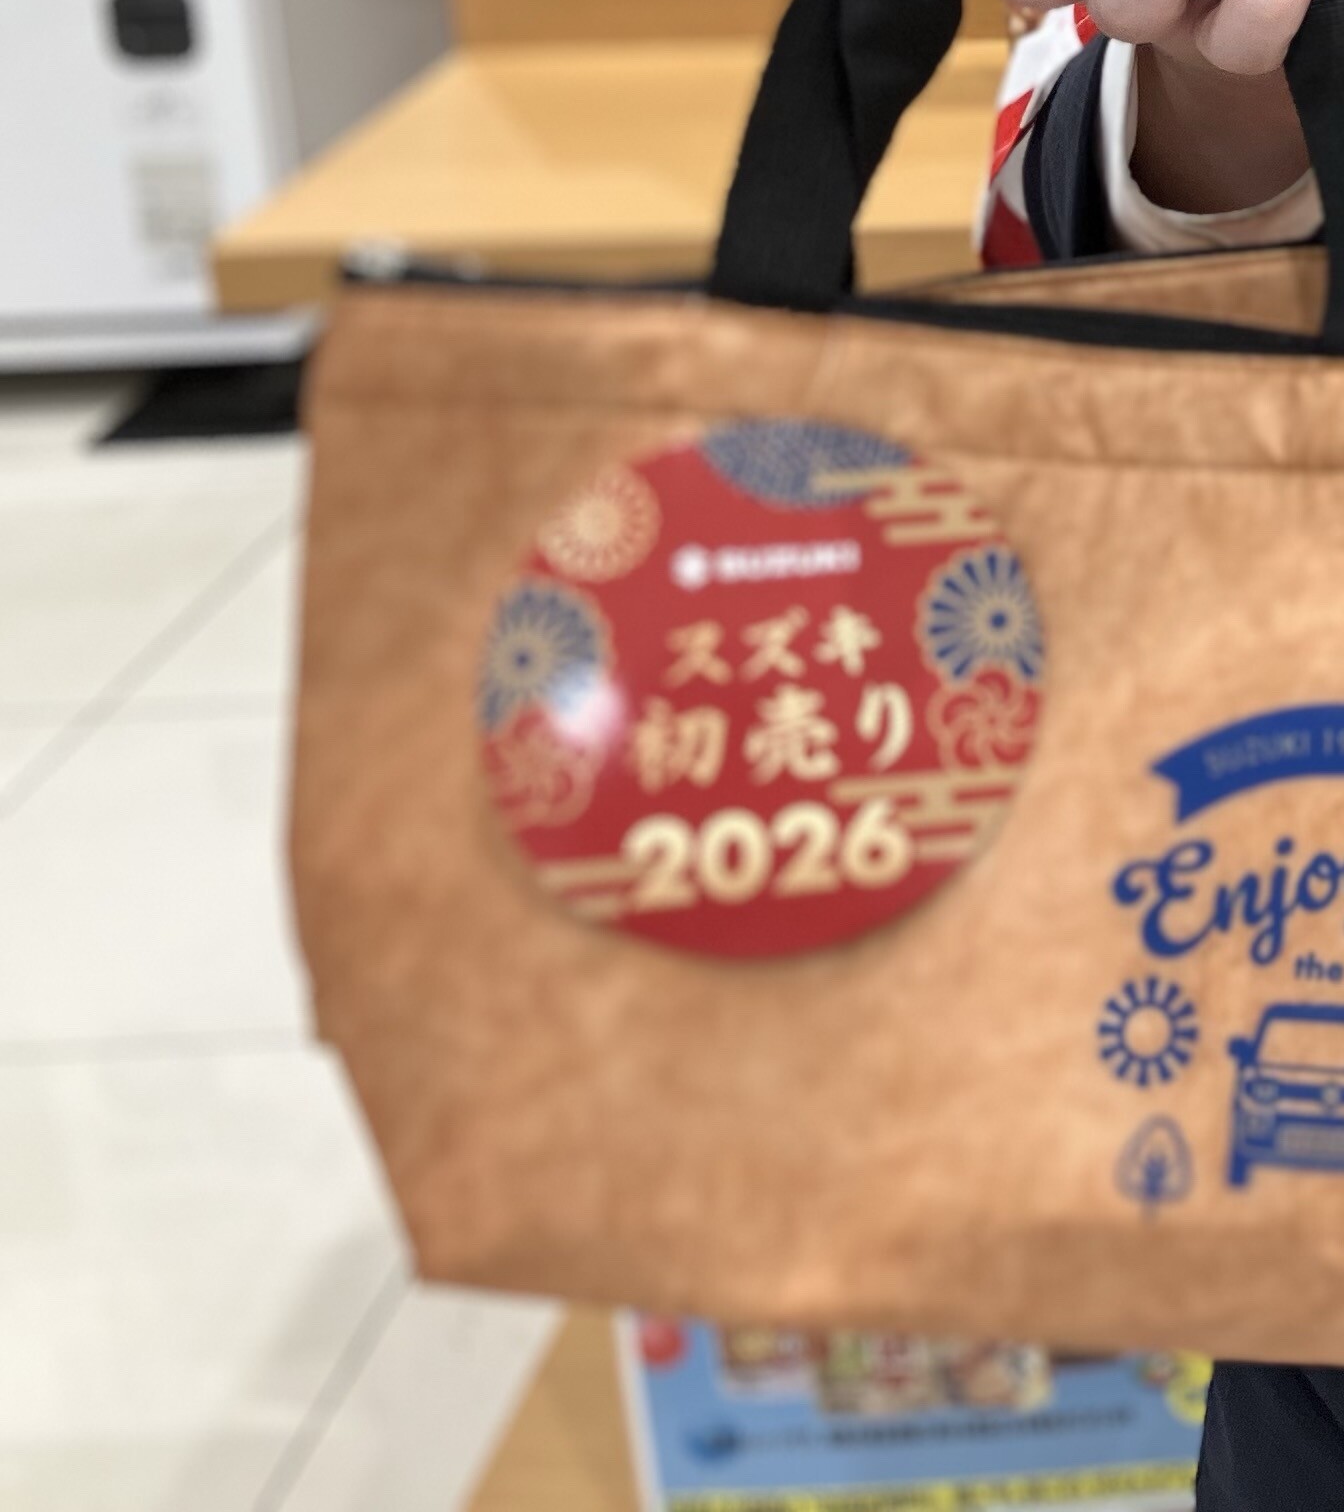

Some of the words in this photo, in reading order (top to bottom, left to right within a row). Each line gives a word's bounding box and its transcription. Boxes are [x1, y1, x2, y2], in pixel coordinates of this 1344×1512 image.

[663, 604, 882, 687] スズキ
[632, 682, 914, 793] 初売り
[620, 797, 915, 916] 2026
[1295, 952, 1344, 981] the
